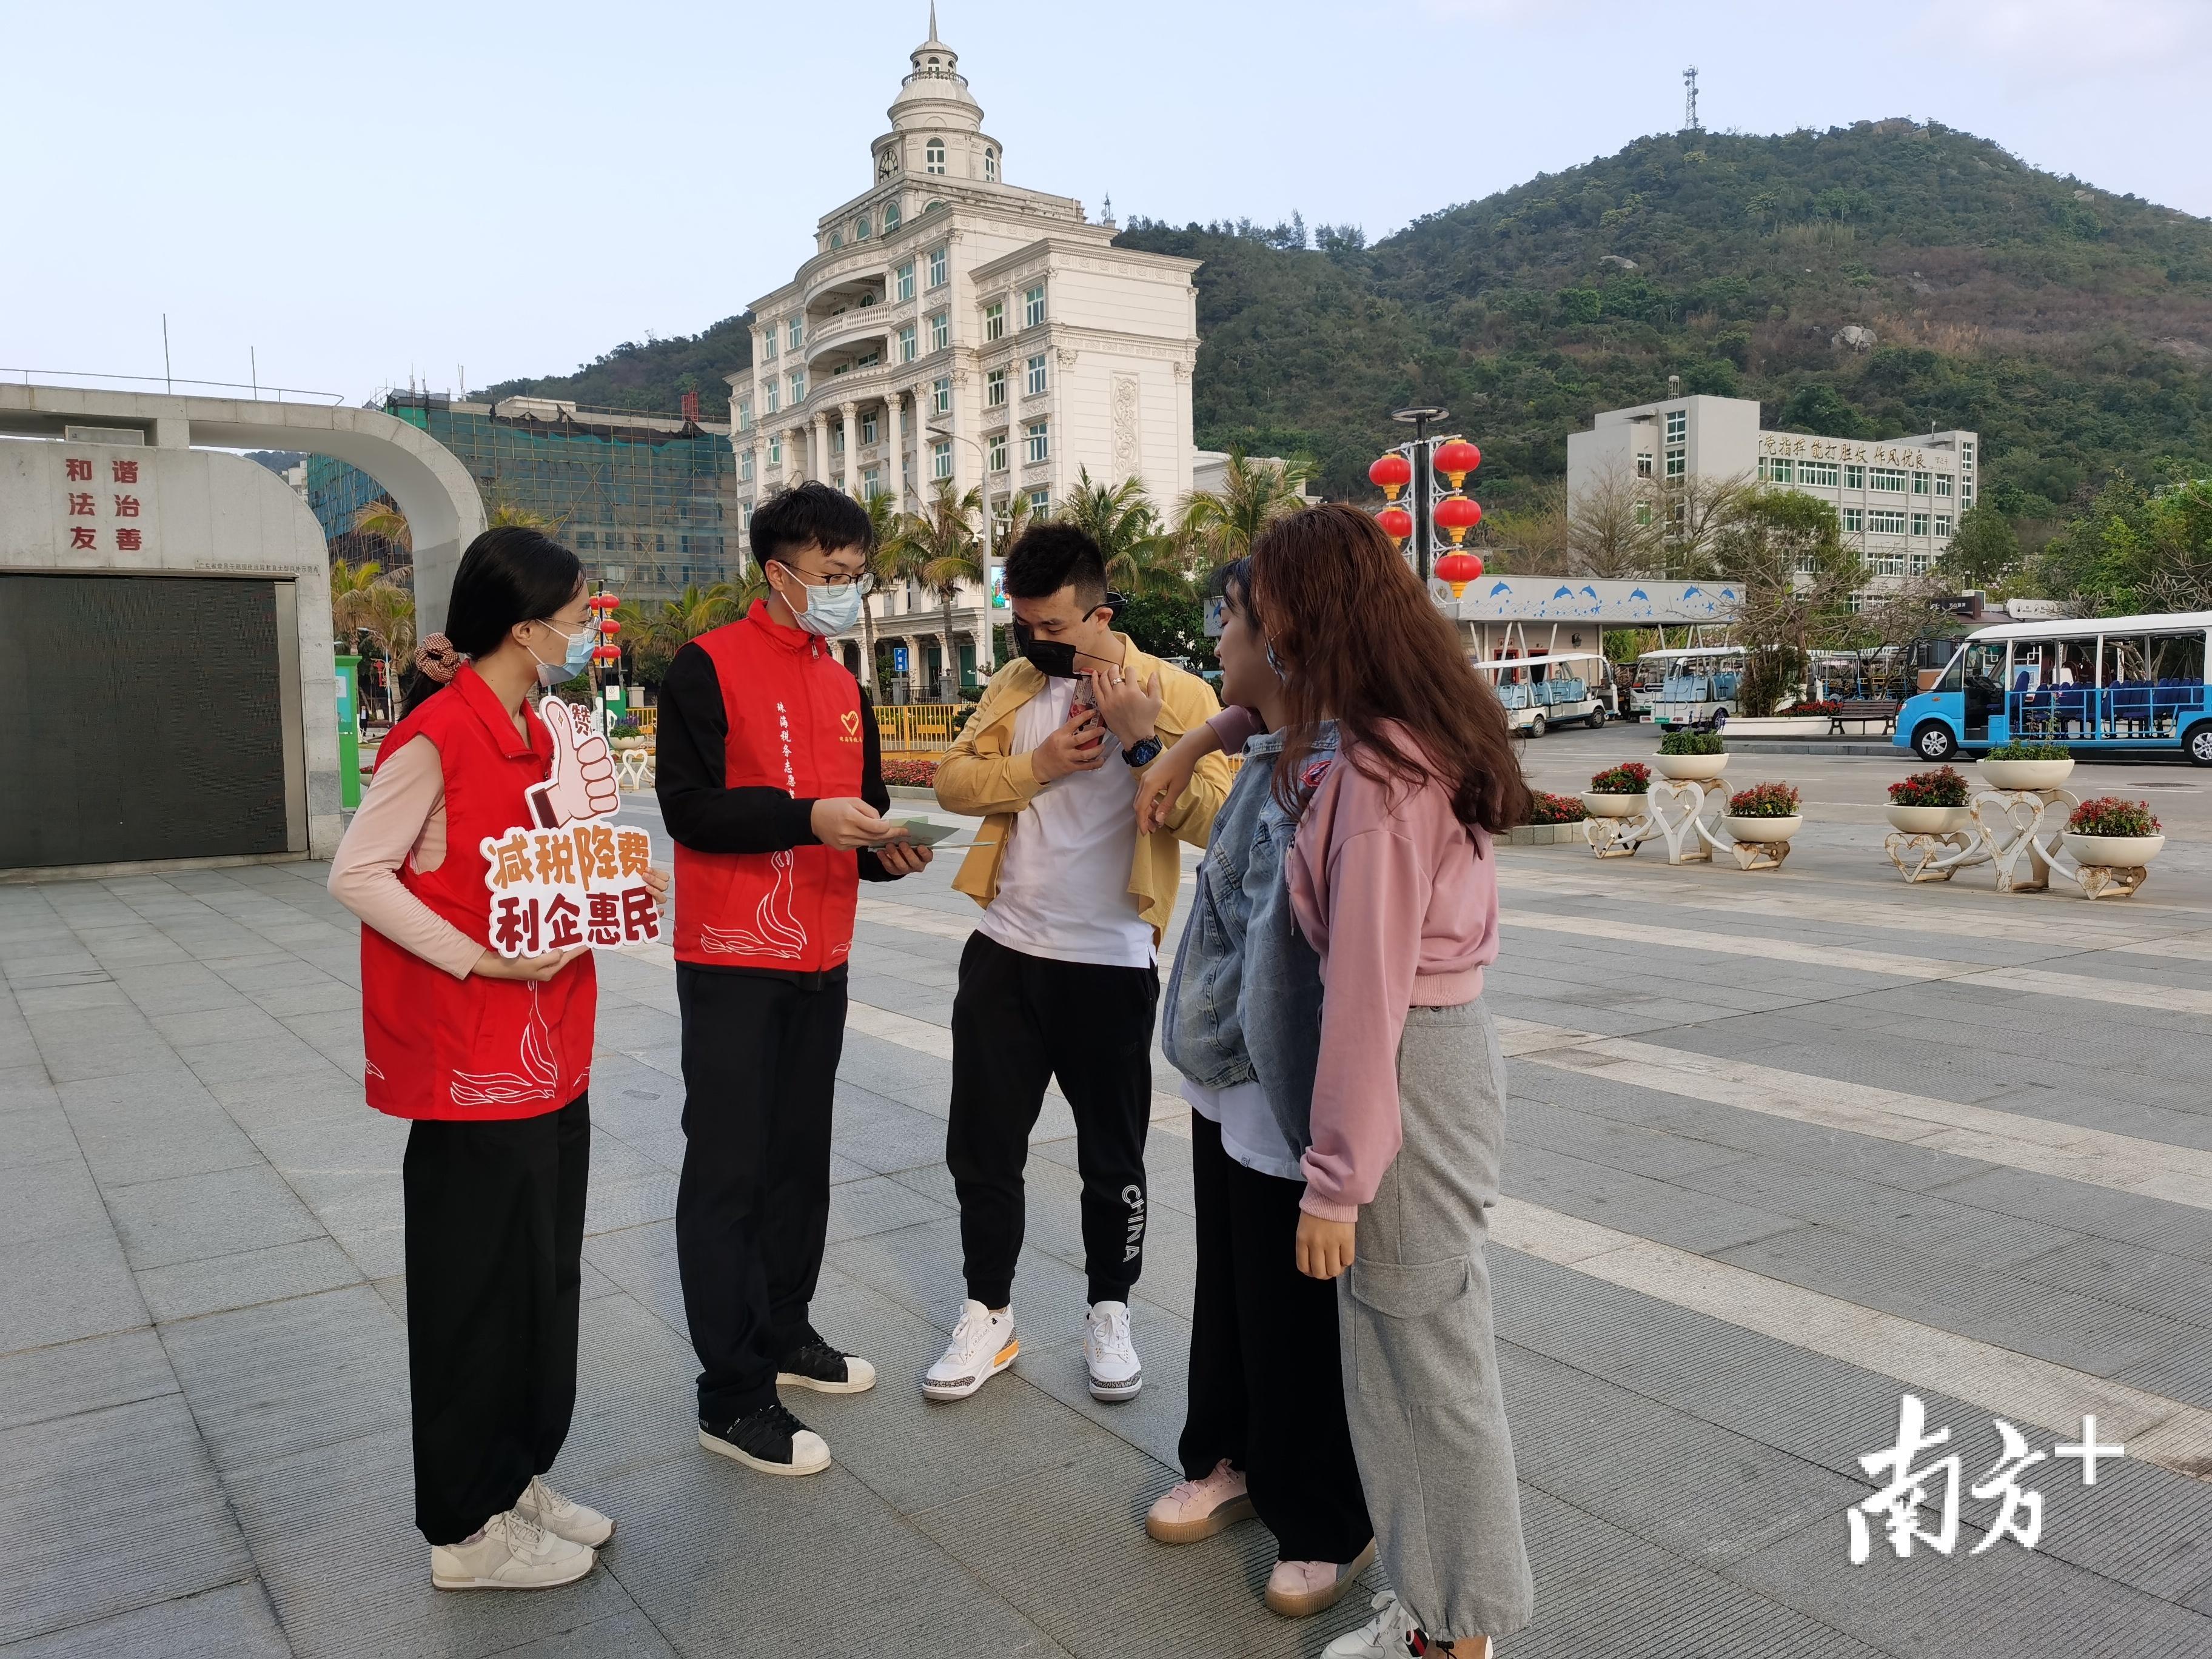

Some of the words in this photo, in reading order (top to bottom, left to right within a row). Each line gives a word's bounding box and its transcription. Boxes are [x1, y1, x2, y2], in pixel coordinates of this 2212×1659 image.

[65, 458, 138, 484] 和谐
[68, 492, 141, 517] 法治
[70, 526, 142, 551] 友善
[571, 705, 591, 736] 赞
[487, 825, 649, 891] 减税降费
[495, 885, 659, 952] 利企惠民
[1122, 1185, 1145, 1262] CHINA
